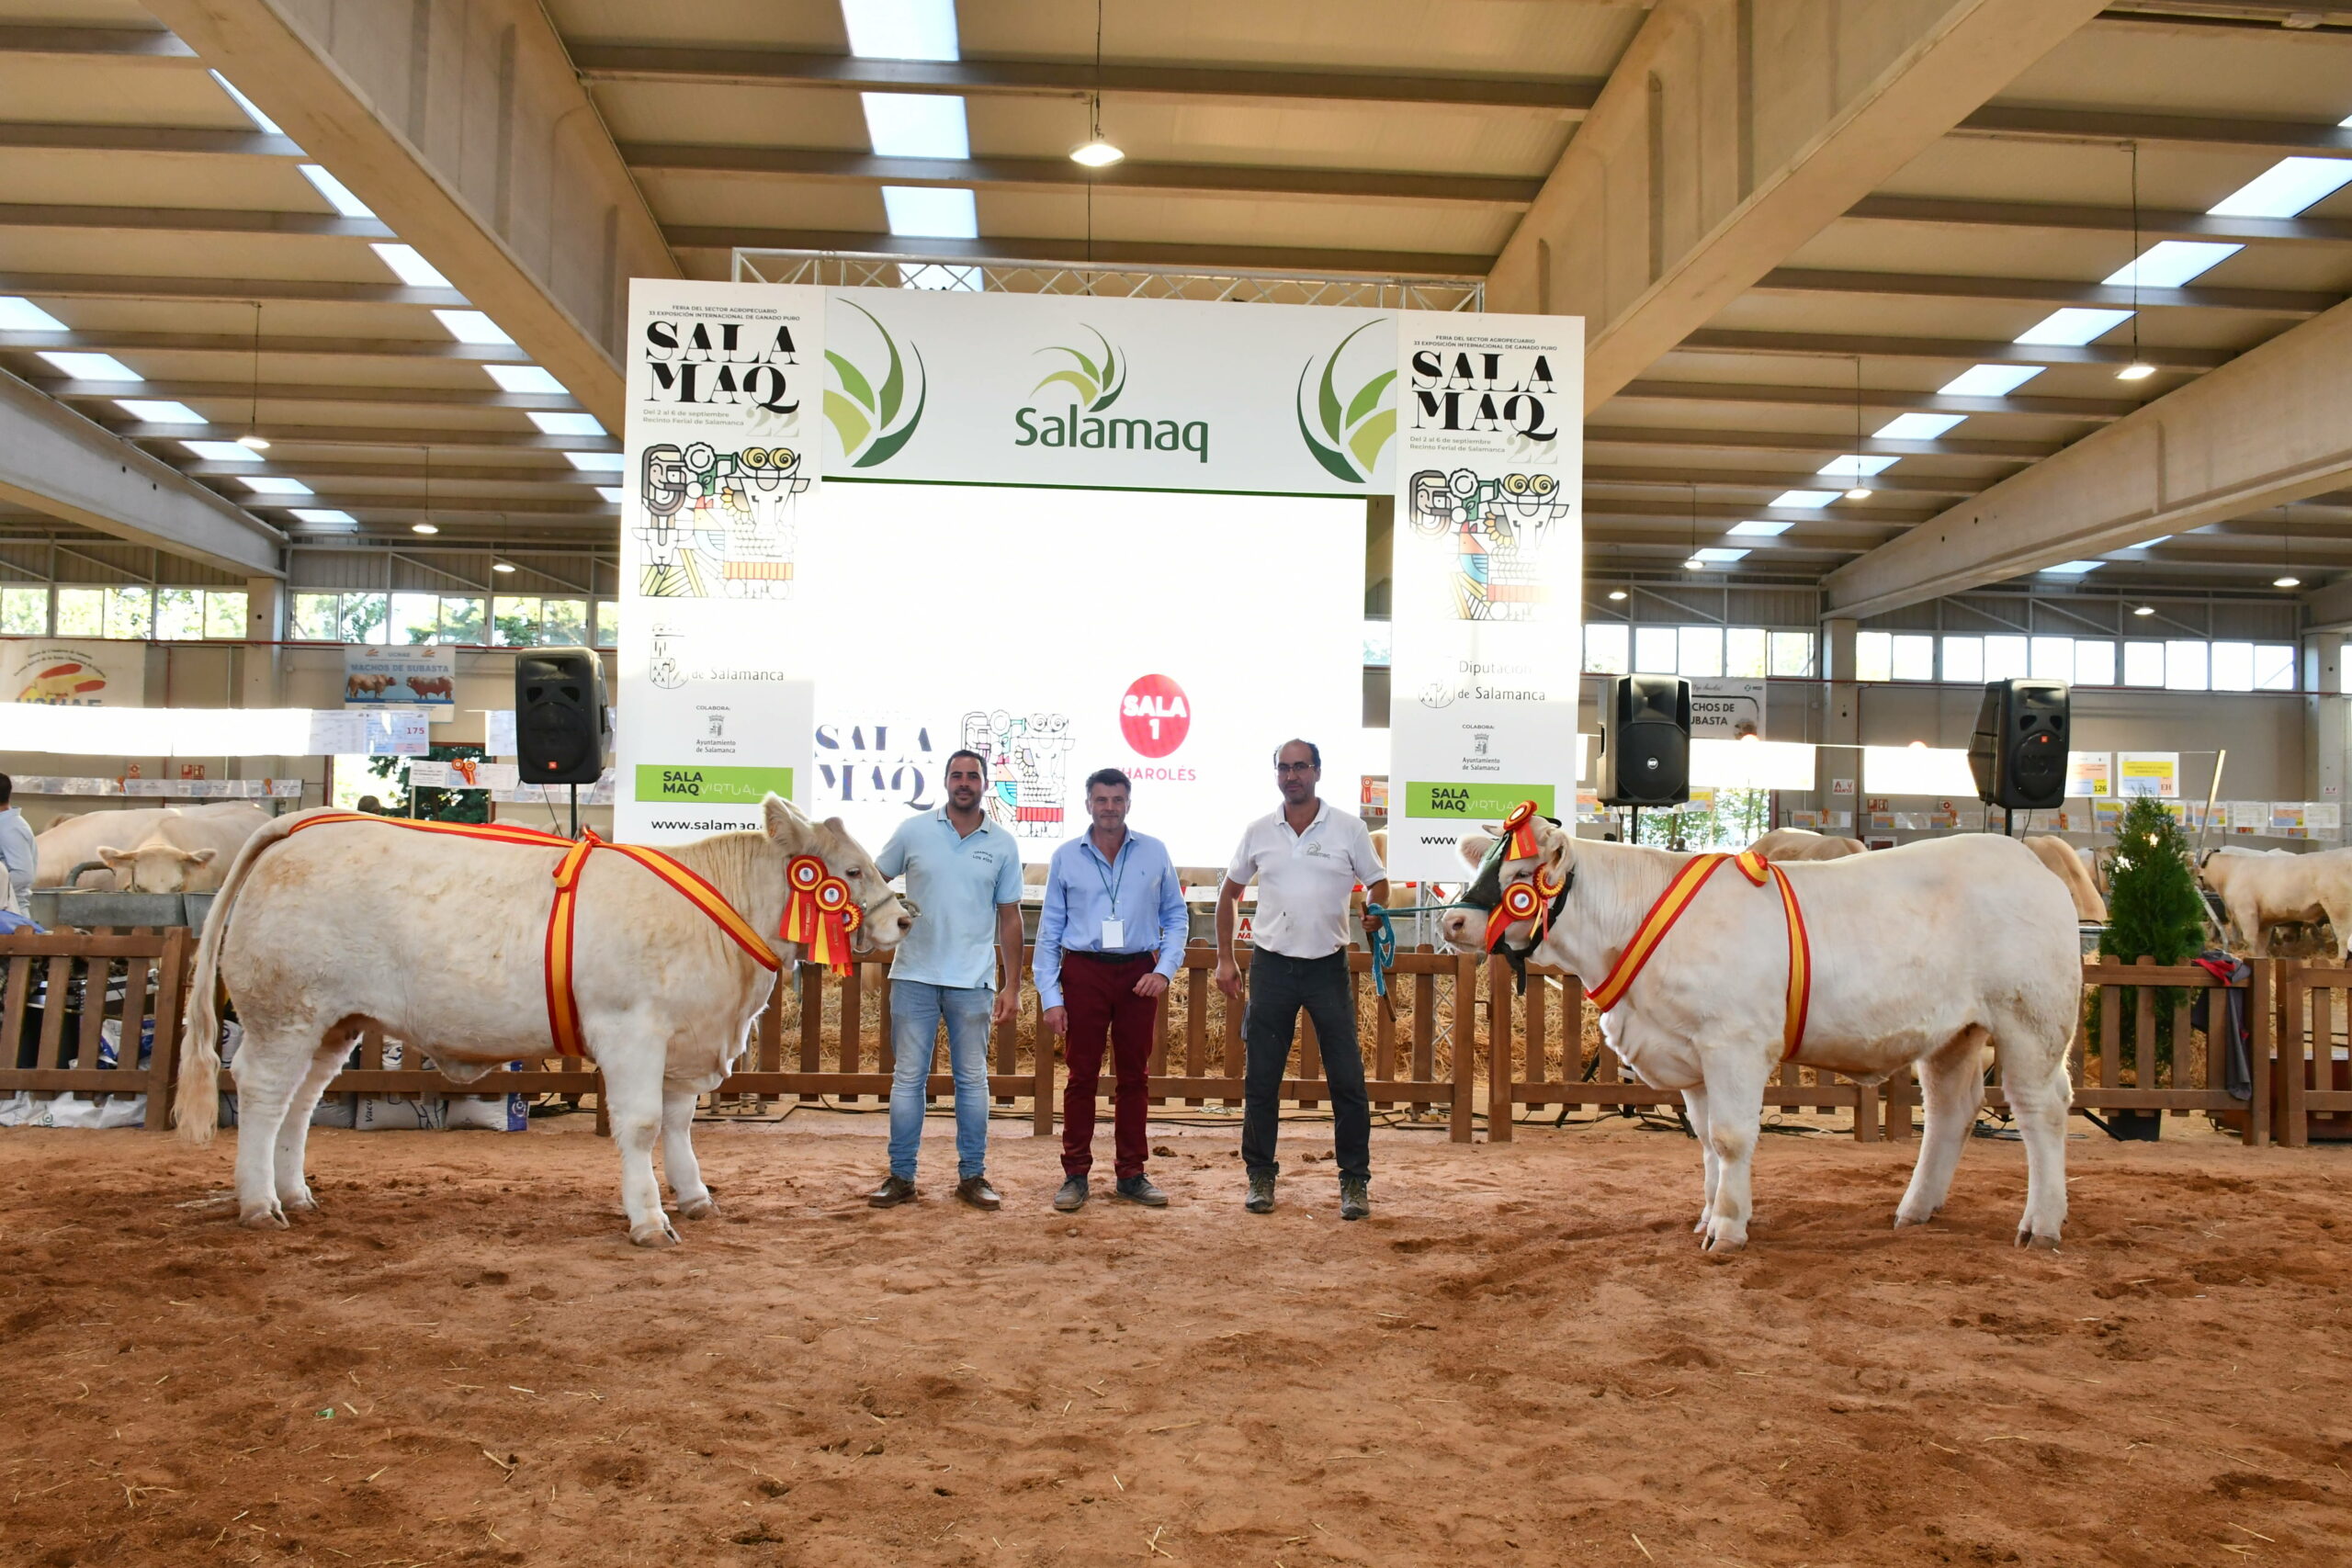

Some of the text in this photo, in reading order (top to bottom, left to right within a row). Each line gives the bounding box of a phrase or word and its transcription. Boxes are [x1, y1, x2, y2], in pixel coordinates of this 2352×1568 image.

[646, 321, 800, 366] SALA
[1411, 350, 1558, 394] SALA
[644, 362, 800, 414] MAQ
[689, 411, 729, 419] septiembre
[1410, 389, 1558, 442] MAQ
[1015, 404, 1208, 463] Salamaq
[1453, 437, 1491, 446] septiembre
[351, 663, 390, 671] MACHOS
[407, 664, 449, 672] SUBASTA
[710, 666, 785, 682] Salamanca
[1457, 686, 1545, 701] de Salamanca
[1123, 694, 1187, 717] SALA
[1691, 703, 1735, 712] CHOS DE
[1690, 716, 1728, 726] UBASTA
[407, 727, 424, 735] 175
[1148, 718, 1159, 739] 1
[695, 739, 736, 748] Ayuntamiento
[1462, 757, 1500, 765] Ayuntamiento
[662, 771, 704, 783] SALA
[1114, 765, 1197, 782] HAROLÉS
[662, 783, 700, 796] MAQ
[1431, 788, 1470, 799] SALA
[1431, 799, 1516, 813] MAQ VIRTUA
